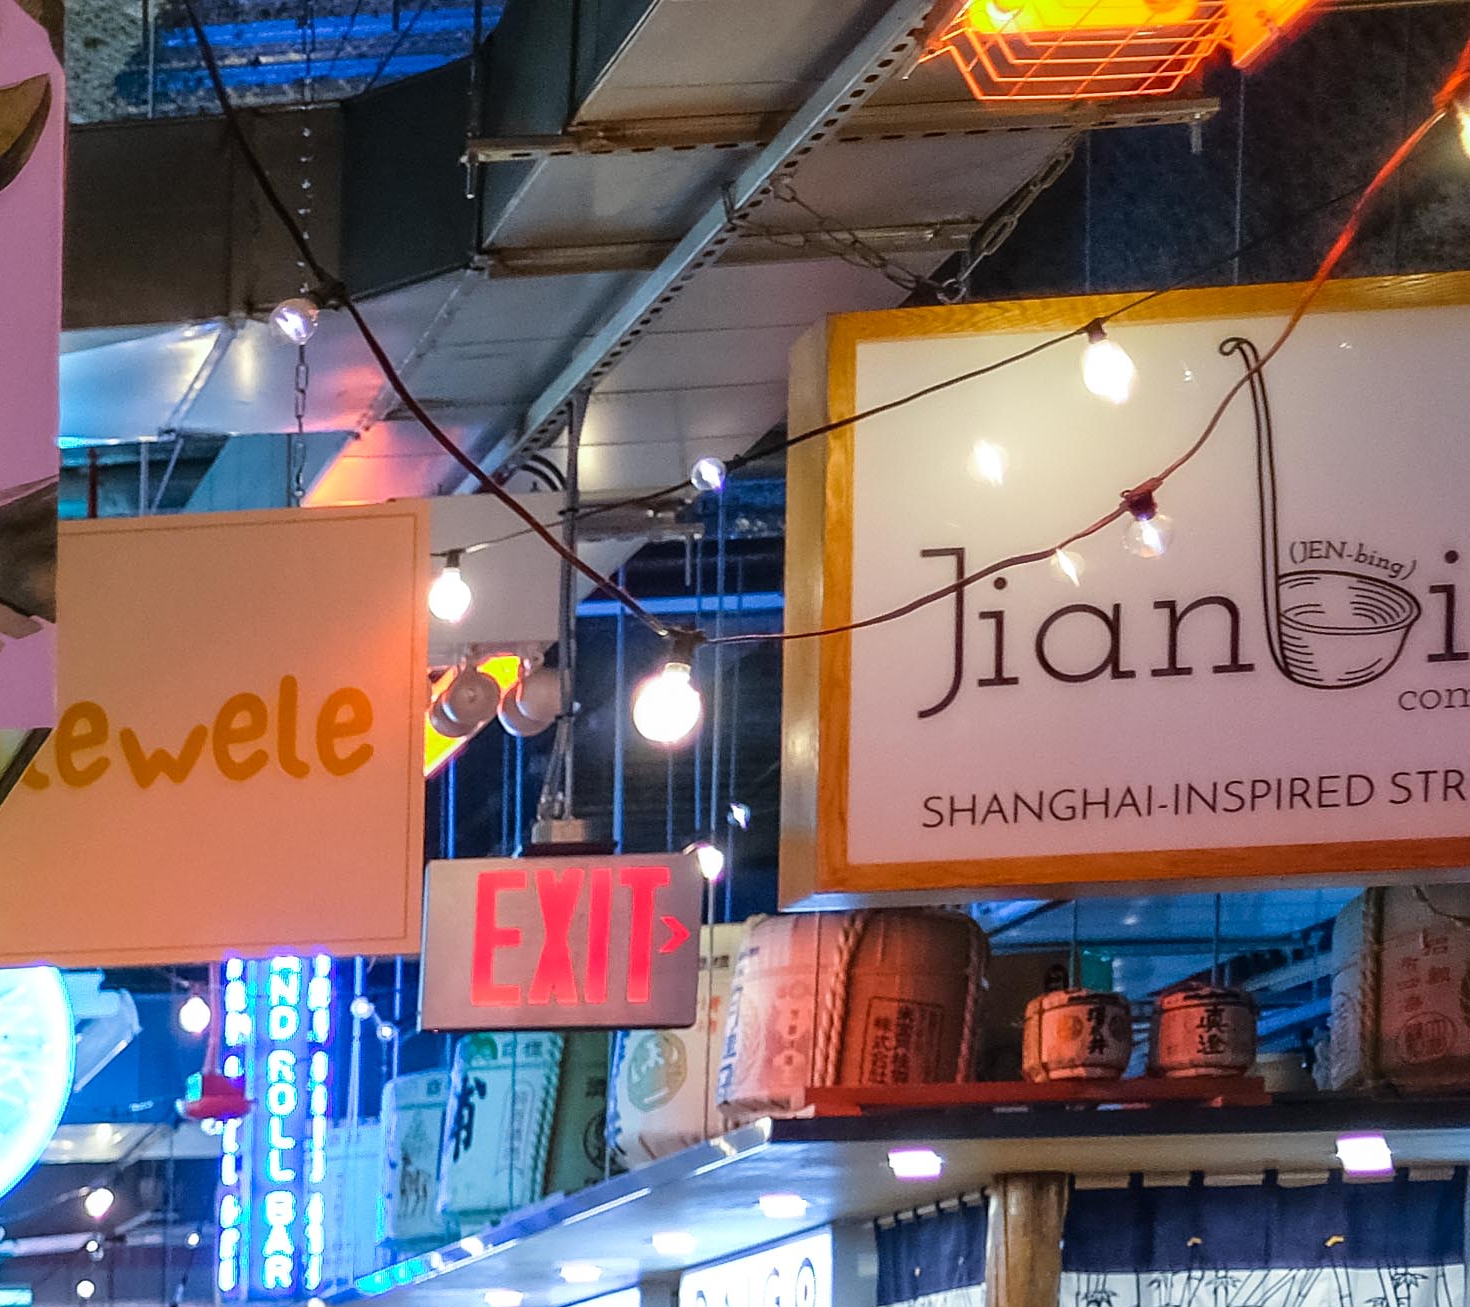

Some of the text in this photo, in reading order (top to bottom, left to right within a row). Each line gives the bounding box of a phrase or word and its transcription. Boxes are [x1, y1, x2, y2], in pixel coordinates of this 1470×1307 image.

[1289, 540, 1417, 581] (JEN-bing)
[922, 768, 1467, 830] SHANGHAI-INSPIRED STR
[473, 865, 669, 1008] EXIT
[262, 1190, 296, 1289] BAR
